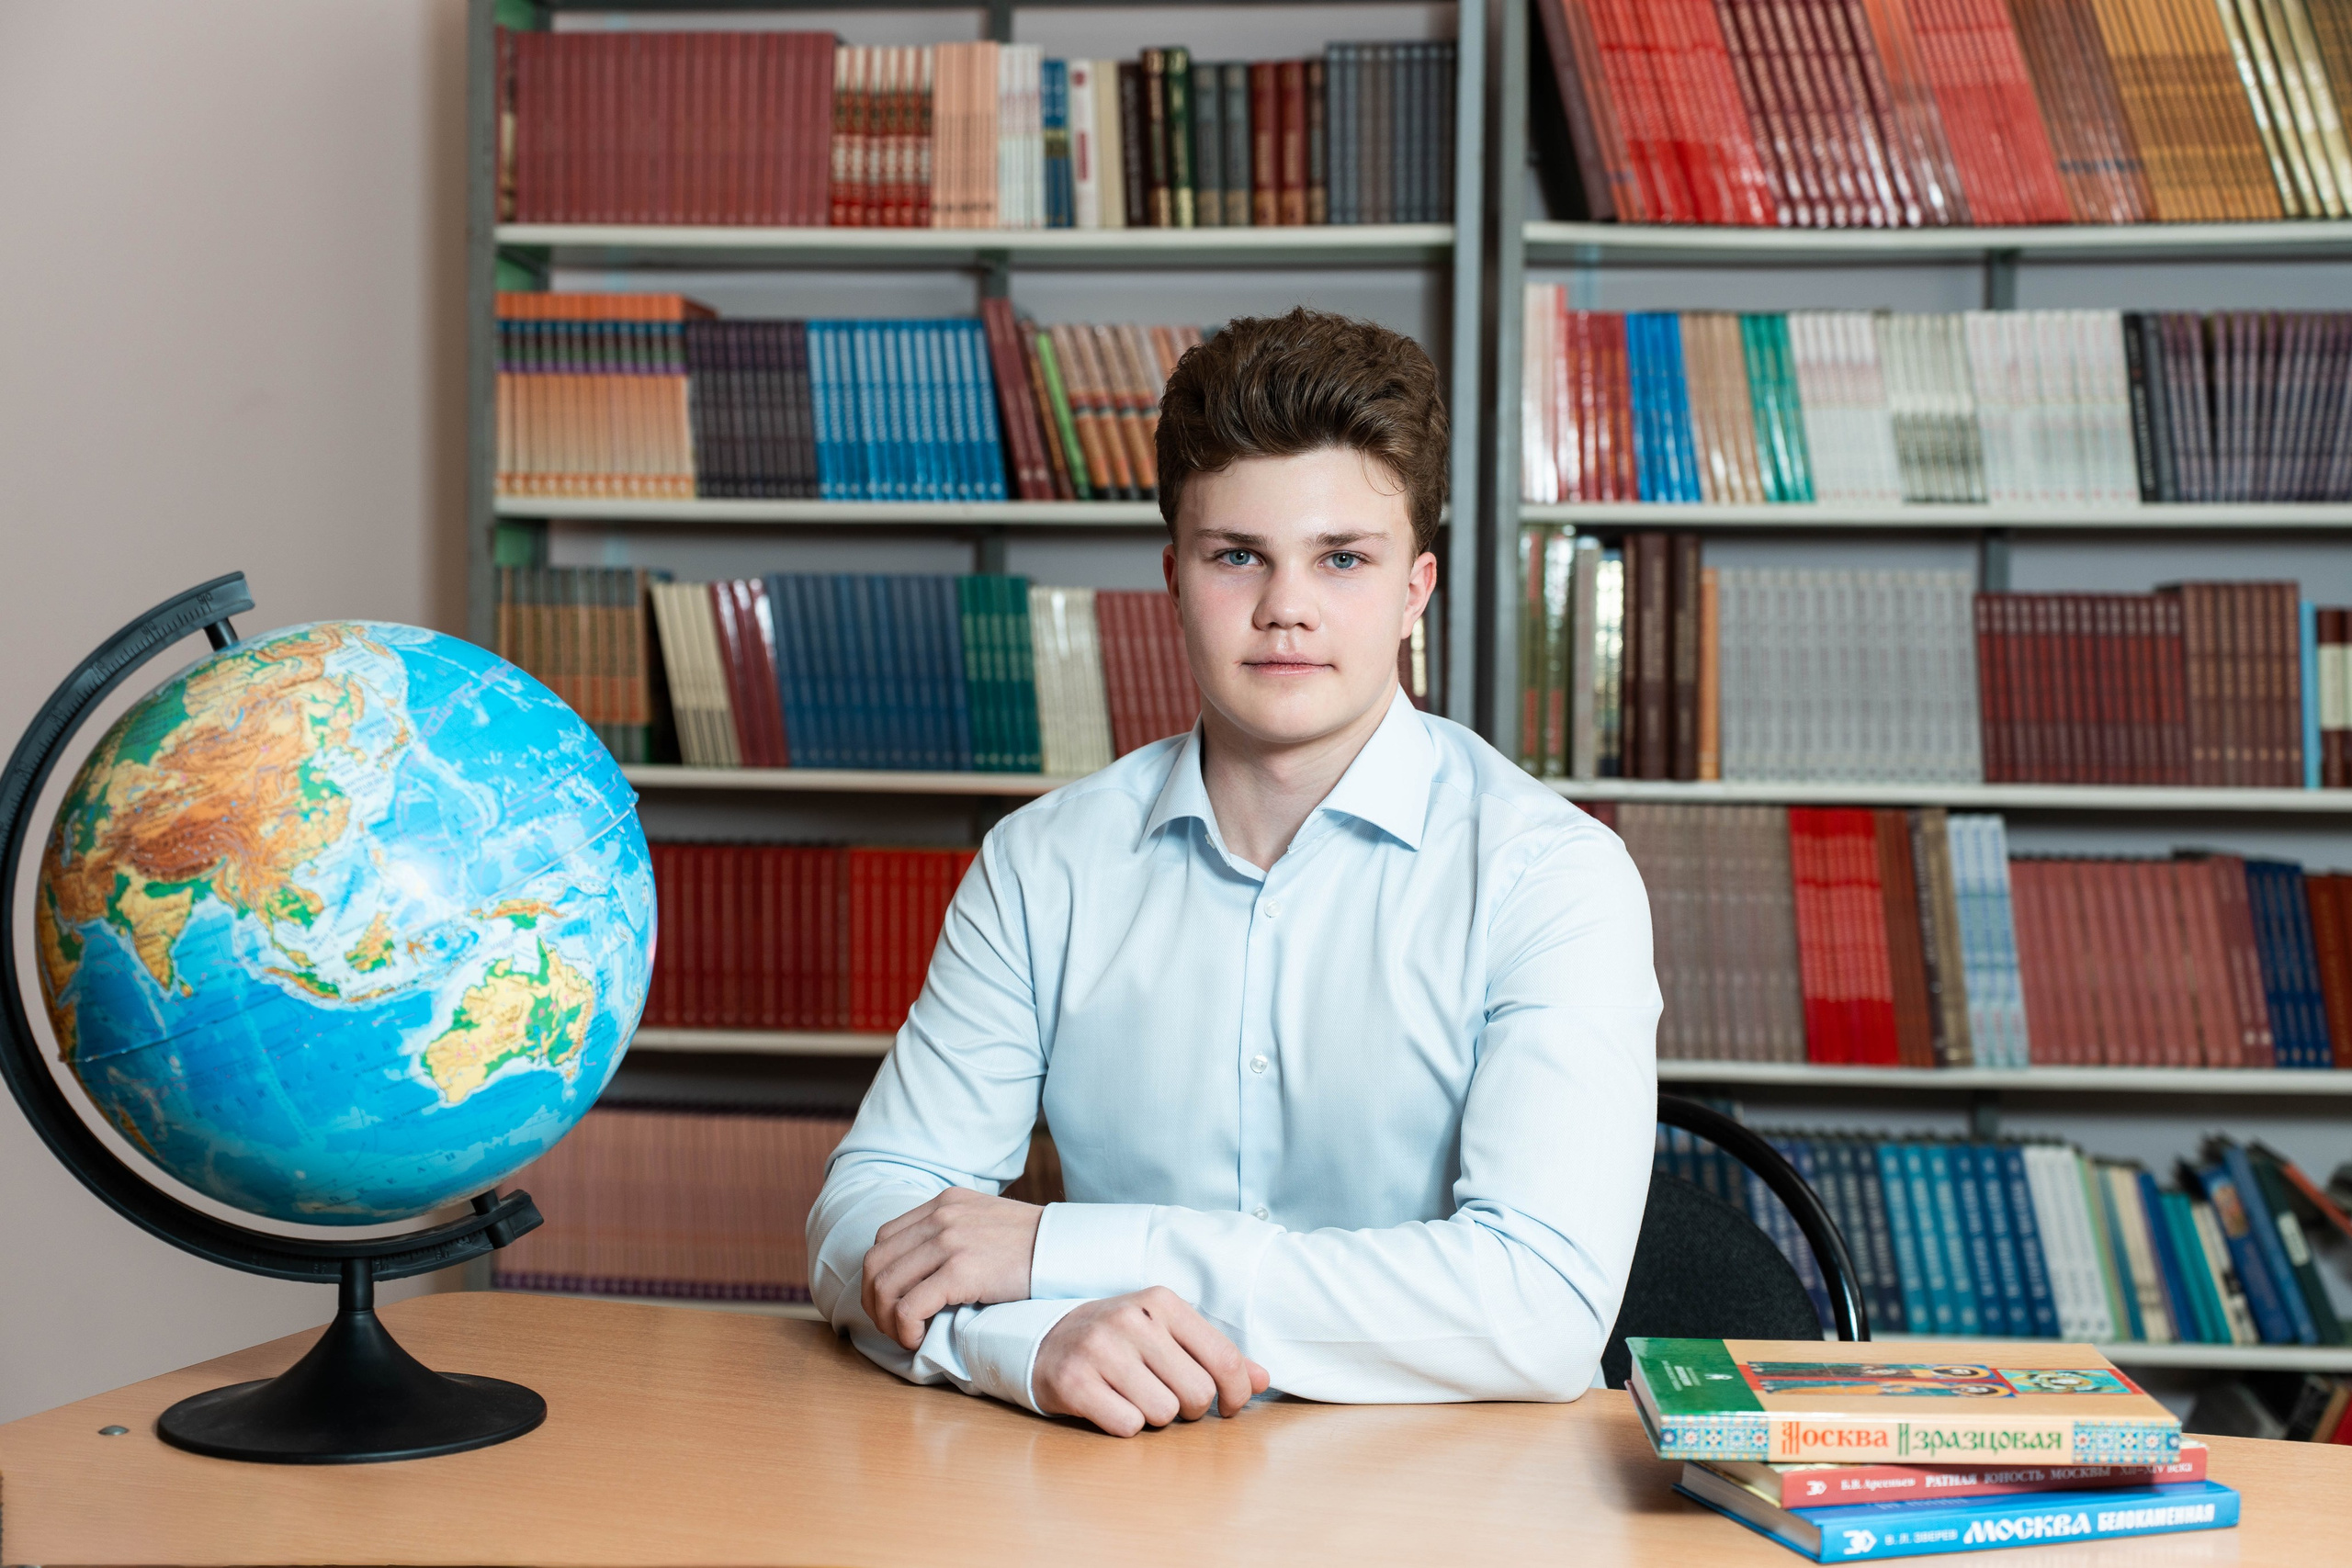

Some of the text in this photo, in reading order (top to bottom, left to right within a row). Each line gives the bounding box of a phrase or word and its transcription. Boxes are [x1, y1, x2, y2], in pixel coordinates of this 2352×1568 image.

[1781, 1421, 2063, 1457] Москва Изразцовая
[1925, 1472, 1977, 1488] РАТНАЯ
[1984, 1469, 2045, 1484] ЮНОСТЬ
[2050, 1466, 2111, 1481] МОСКВЫ
[1963, 1512, 2092, 1545] МОСКВА
[2097, 1503, 2215, 1532] БЕЛОКАМЕННАЯ
